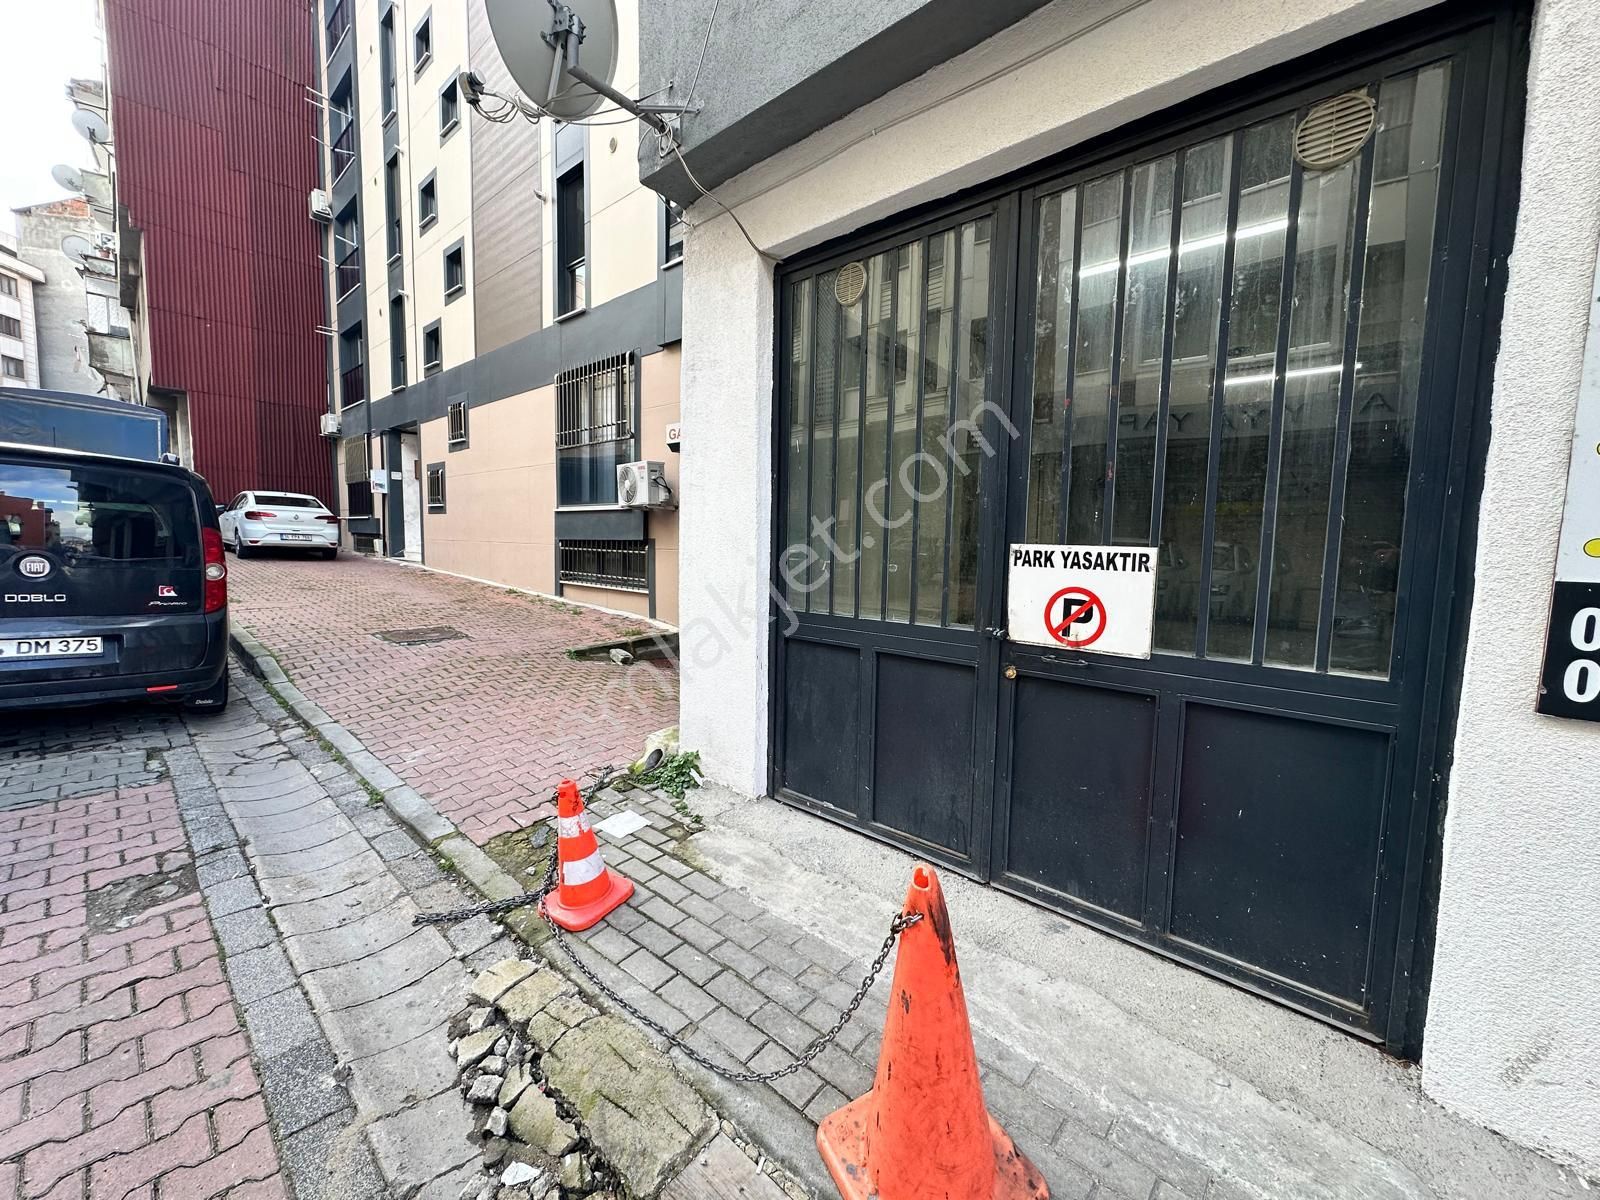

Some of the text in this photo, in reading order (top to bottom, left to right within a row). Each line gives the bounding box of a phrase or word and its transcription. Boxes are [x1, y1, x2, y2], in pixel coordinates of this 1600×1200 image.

[26, 562, 45, 573] FIAT
[1013, 550, 1150, 573] PARK YASAKTIR
[4, 594, 67, 602] DOBLO
[1061, 598, 1094, 637] P
[1570, 607, 1600, 651] 0
[16, 641, 50, 654] DM
[58, 639, 98, 653] 375
[1563, 659, 1600, 703] 0
